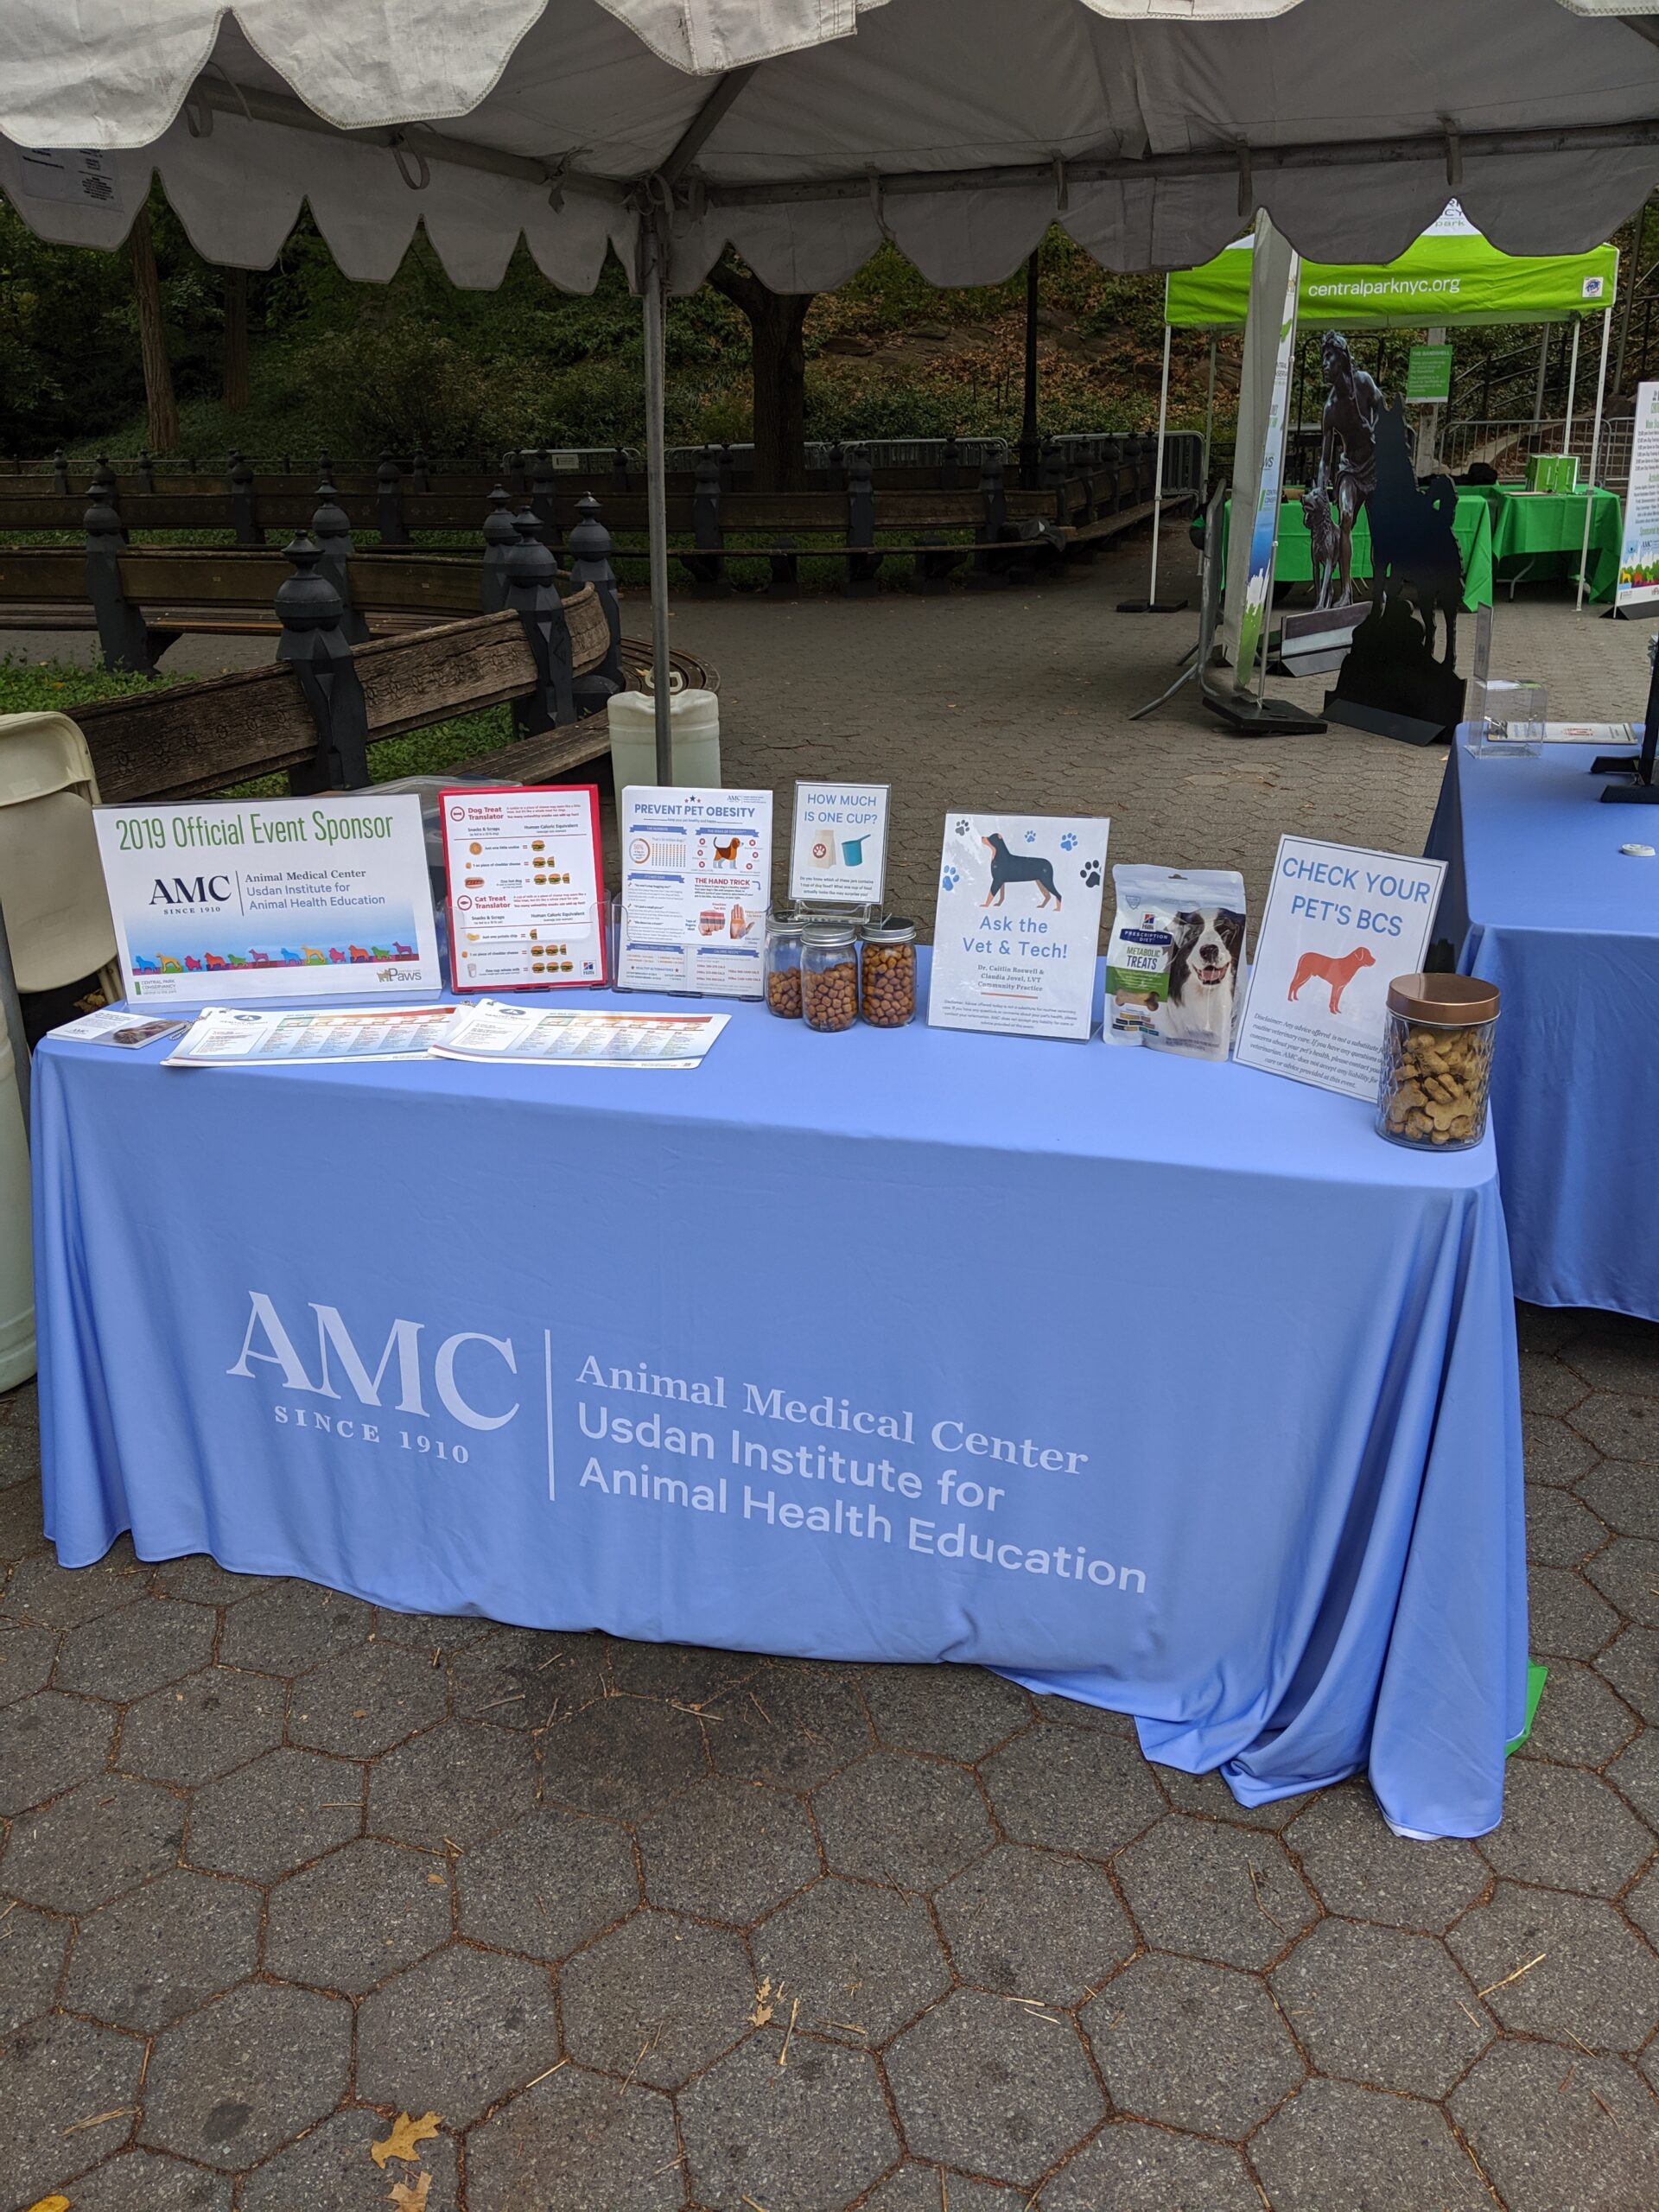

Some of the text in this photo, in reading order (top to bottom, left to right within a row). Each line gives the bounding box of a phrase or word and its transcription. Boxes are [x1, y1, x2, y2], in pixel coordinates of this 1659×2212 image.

[1308, 277, 1460, 297] centralparknyc.org
[807, 793, 876, 807] HOW MUCH
[634, 804, 755, 817] PREVENT PET OBESITY
[804, 811, 878, 824] IS ONE CUP?
[116, 810, 394, 850] 2019 Official Event Sponsor
[245, 869, 366, 883] Animal Medical Center
[1282, 857, 1431, 904] CHECK YOUR
[149, 875, 232, 905] AMC
[247, 881, 350, 896] Usdan Institute for
[249, 894, 385, 911] Animal Health Education
[980, 916, 1048, 933] Ask the
[1291, 894, 1403, 937] PET'S BCS
[1125, 931, 1168, 939] PRESCRIPTION
[963, 938, 1068, 959] Vet & Tech!
[1127, 946, 1160, 957] METABOLIC
[1127, 956, 1158, 970] TREATS
[389, 968, 422, 982] Paws
[978, 982, 1015, 990] Community
[1253, 1024, 1271, 1033] routine
[1272, 1029, 1297, 1041] veterinary
[1327, 1043, 1340, 1052] have
[1351, 1051, 1377, 1062] questions
[1294, 1025, 1311, 1033] advice
[1312, 1029, 1332, 1039] offered
[1351, 1040, 1379, 1052] substitute
[1250, 1033, 1271, 1042] concerns
[1272, 1039, 1287, 1047] about
[1332, 1056, 1349, 1065] please
[1349, 1061, 1370, 1071] contact
[1283, 1062, 1300, 1071] advice
[1300, 1068, 1324, 1079] provided
[1348, 1071, 1370, 1083] liability
[226, 1290, 519, 1431] AMC
[575, 1355, 1090, 1474] Animal Medical Center
[274, 1405, 469, 1464] SINCE 1910
[579, 1402, 1006, 1512] Usdan Institute for
[579, 1457, 1147, 1593] Animal Health Education
